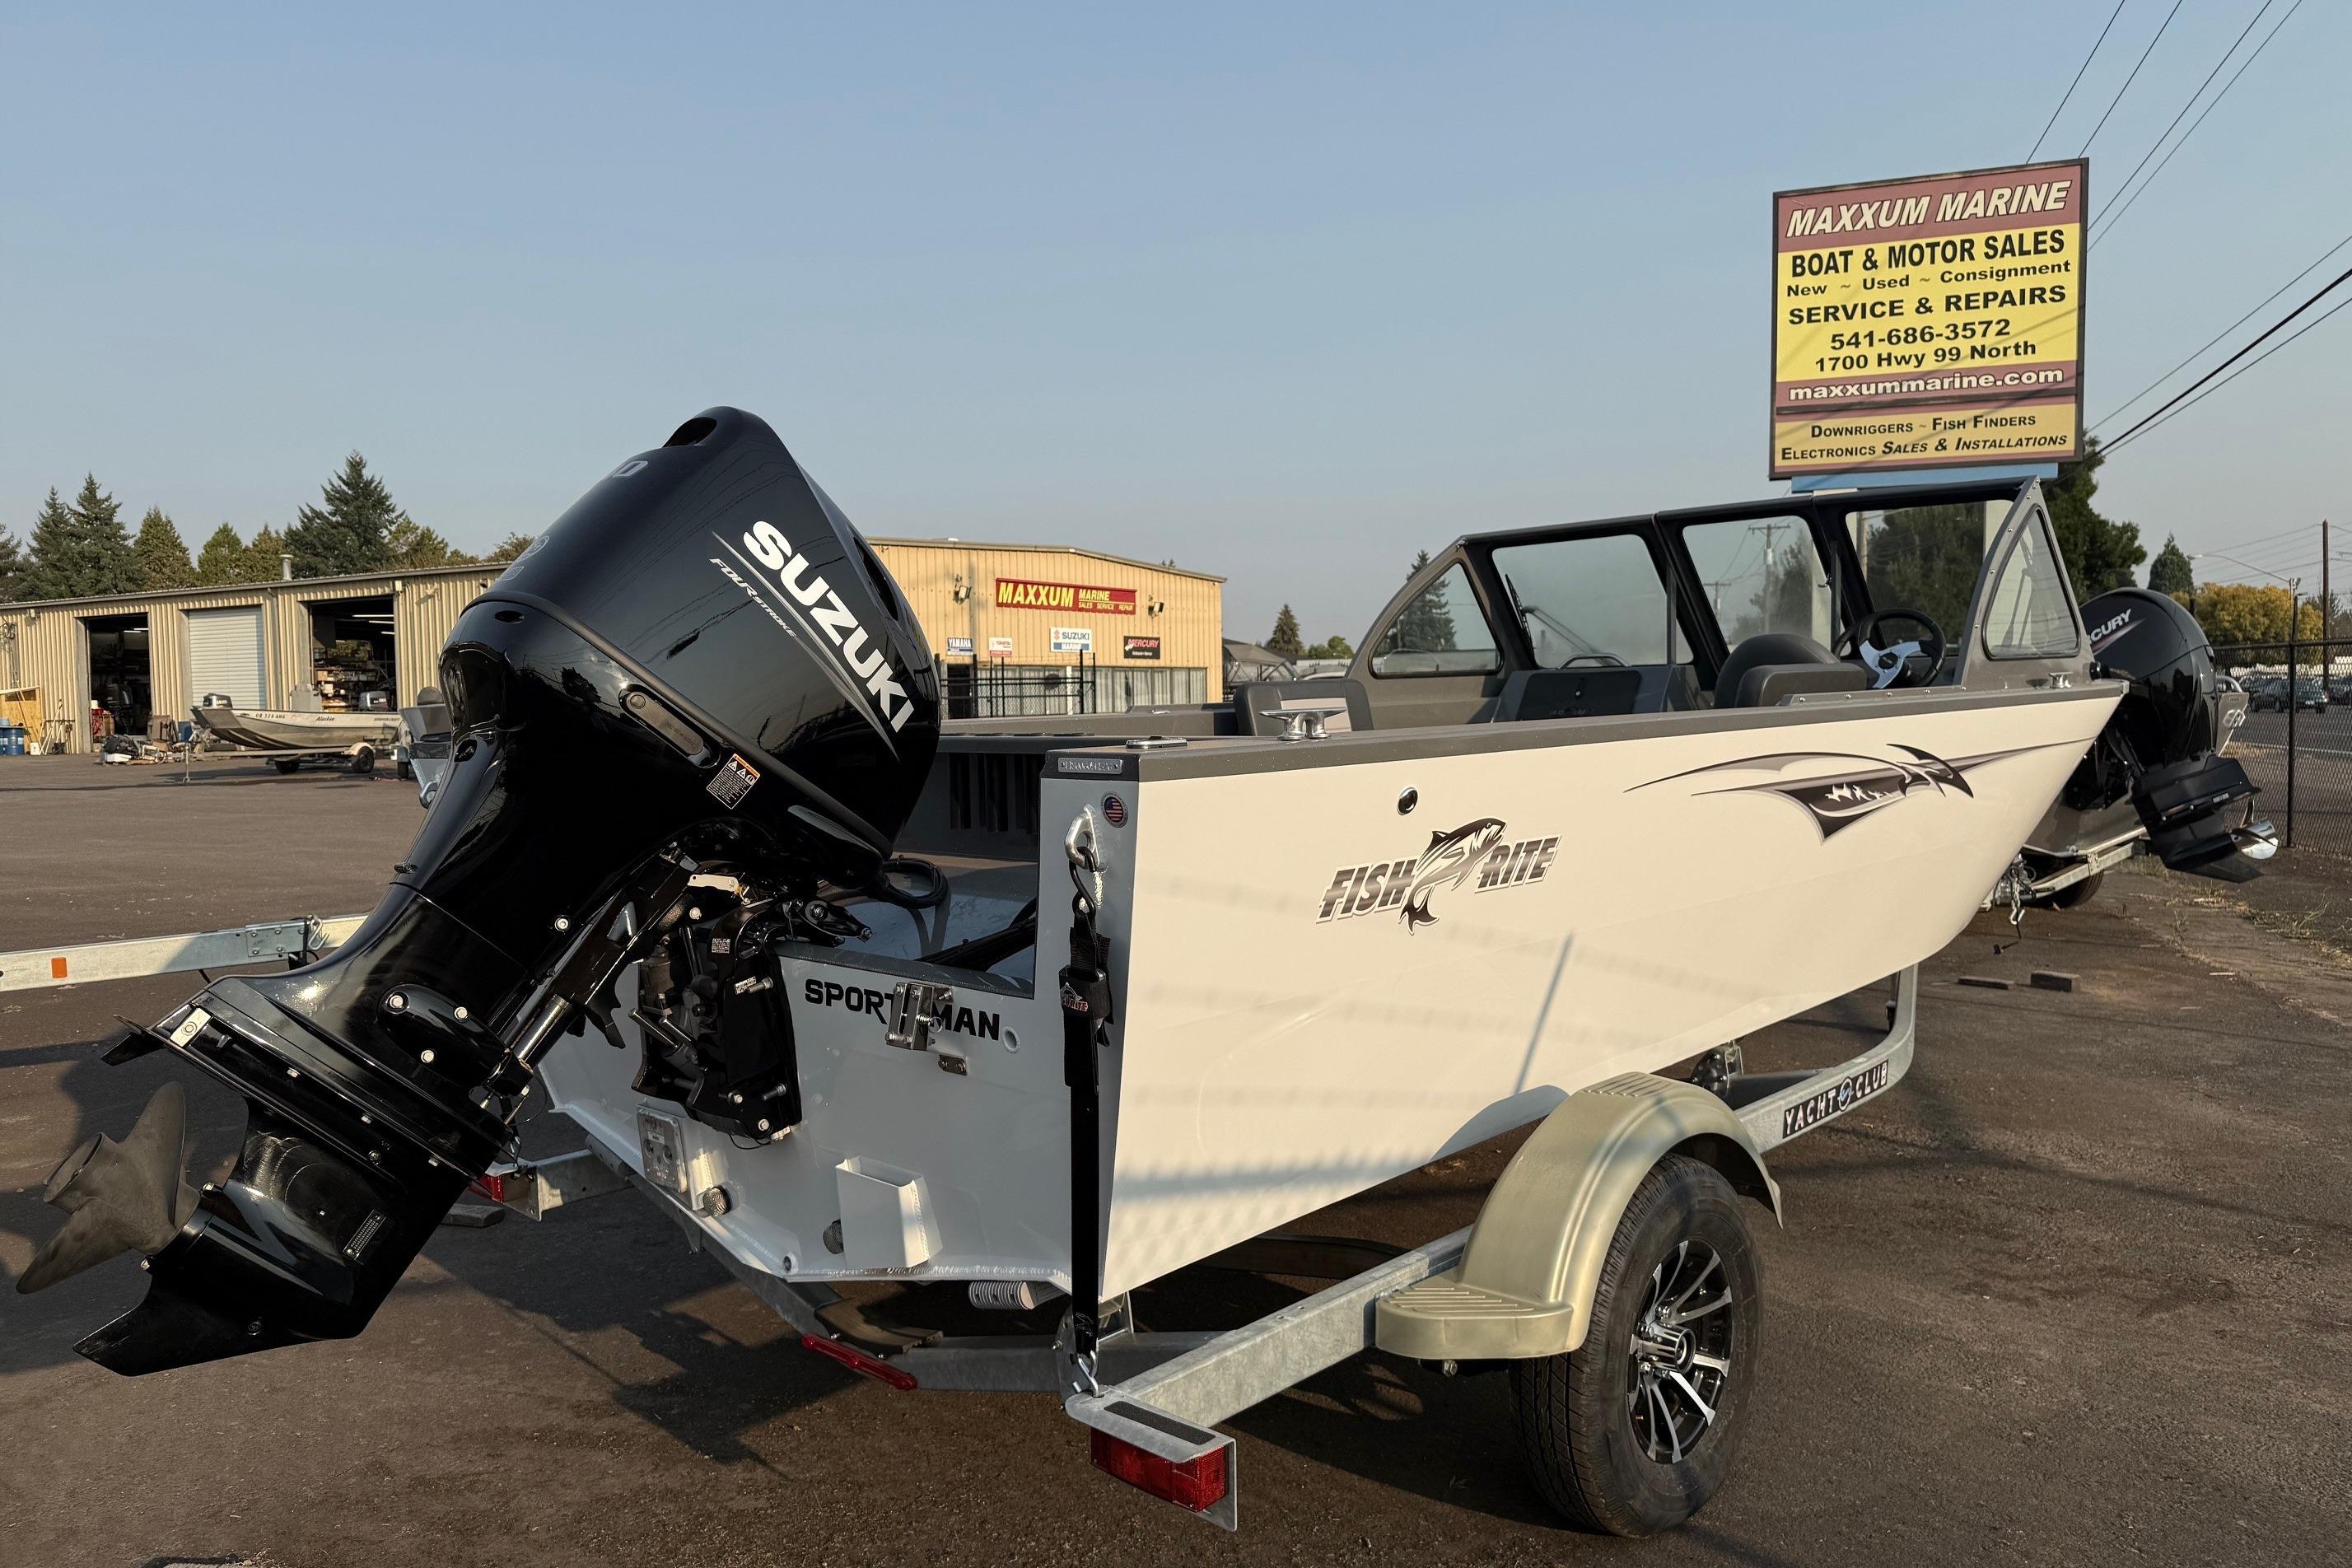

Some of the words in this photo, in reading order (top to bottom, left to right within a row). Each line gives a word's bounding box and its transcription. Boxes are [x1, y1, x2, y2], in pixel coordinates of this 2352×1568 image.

[1785, 195, 1931, 238] MAXXUM
[1935, 180, 2072, 223] MARINE
[1791, 250, 1853, 278] BOAT
[1862, 248, 1878, 271] &
[1888, 238, 1975, 269] MOTOR
[1984, 229, 2065, 259] SALES
[1786, 283, 1827, 296] New
[1863, 275, 1910, 291] Used
[1940, 259, 2070, 283] Consignment
[1789, 299, 1904, 325] SERVICE
[1915, 296, 1934, 315] &
[1944, 285, 2066, 312] REPAIRS
[1830, 319, 2010, 351] 541-686-3572
[1815, 354, 1868, 372] 1700
[1877, 352, 1925, 368] Hwy
[1934, 346, 1961, 362] 99
[1970, 340, 2036, 360] North
[1789, 367, 2064, 401] maxxummarine.com
[1811, 422, 1913, 438] DOWNRIGGERS
[1931, 417, 1967, 432] FISH
[1973, 414, 2036, 428] FINDERS
[1781, 446, 1876, 460] ELECTRONICS
[1881, 441, 1928, 455] SALES
[1934, 438, 1948, 451] &
[1955, 435, 2068, 450] INSTALLATIONS
[998, 581, 1075, 608] MAXXUM
[1078, 589, 1110, 601] MARINE
[1078, 601, 1093, 609] SALES
[742, 520, 915, 733] SUZUKI
[1062, 632, 1090, 641] SUZUKI
[2088, 608, 2131, 642] CURY
[948, 637, 972, 648] YAMAHA
[1127, 638, 1159, 648] MERCURY
[1318, 858, 1418, 922] FISH
[1477, 835, 1561, 893] RITE
[805, 978, 1000, 1041] SPORMAN
[1785, 1089, 1836, 1135] YACHT
[1855, 1062, 1888, 1099] CLUB
